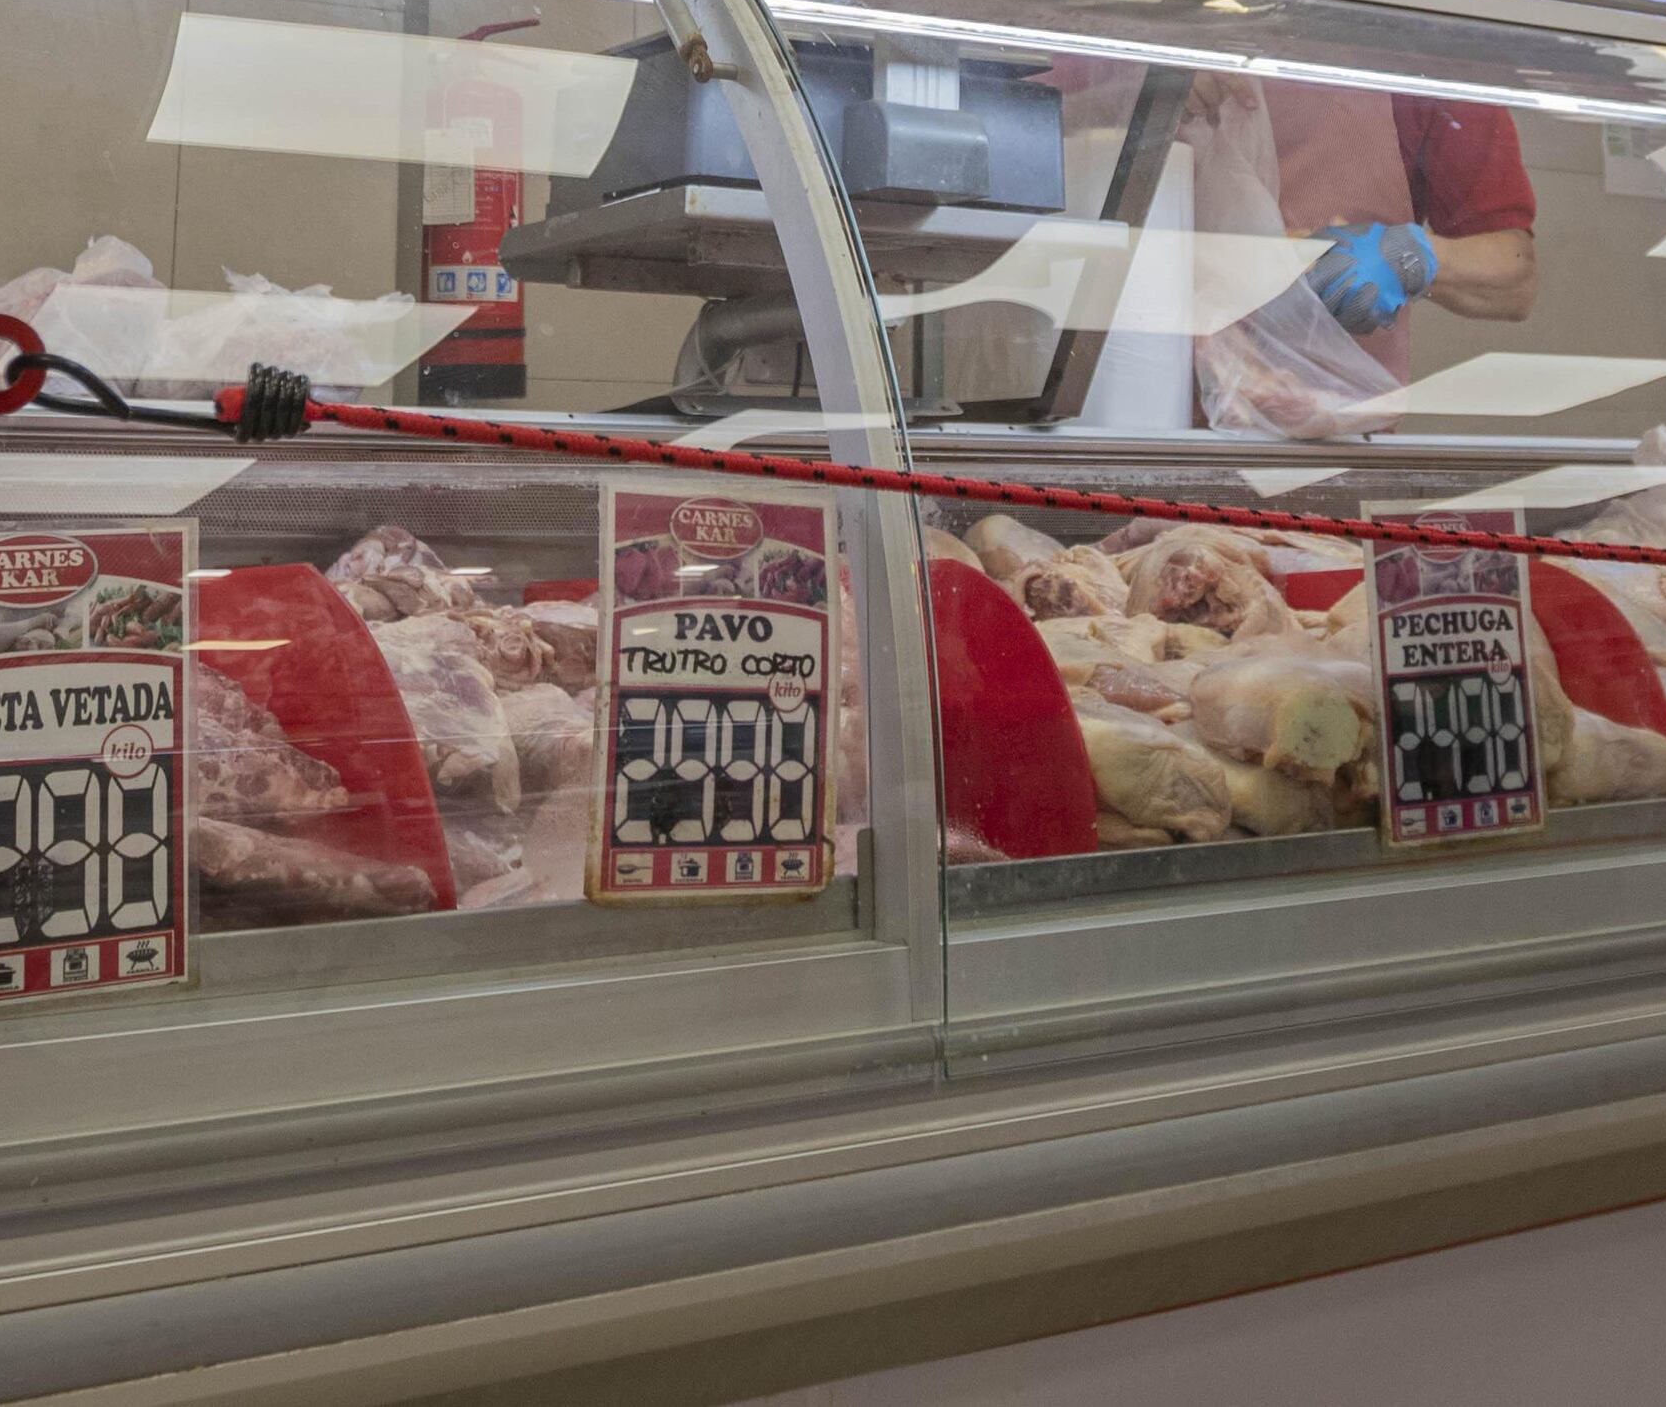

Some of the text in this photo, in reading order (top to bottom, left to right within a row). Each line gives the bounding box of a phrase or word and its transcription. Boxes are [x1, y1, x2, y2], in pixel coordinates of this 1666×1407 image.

[678, 508, 753, 528] CARNES
[695, 524, 736, 542] KAR
[0, 568, 59, 588] KAR
[674, 612, 773, 642] PAVO
[1391, 608, 1514, 639] PECHUGA
[621, 647, 815, 678] TRUTRO CORTO
[1402, 638, 1508, 669] ENTERA
[49, 681, 174, 727] VETADA
[774, 681, 801, 699] kilo
[108, 734, 147, 762] kilo
